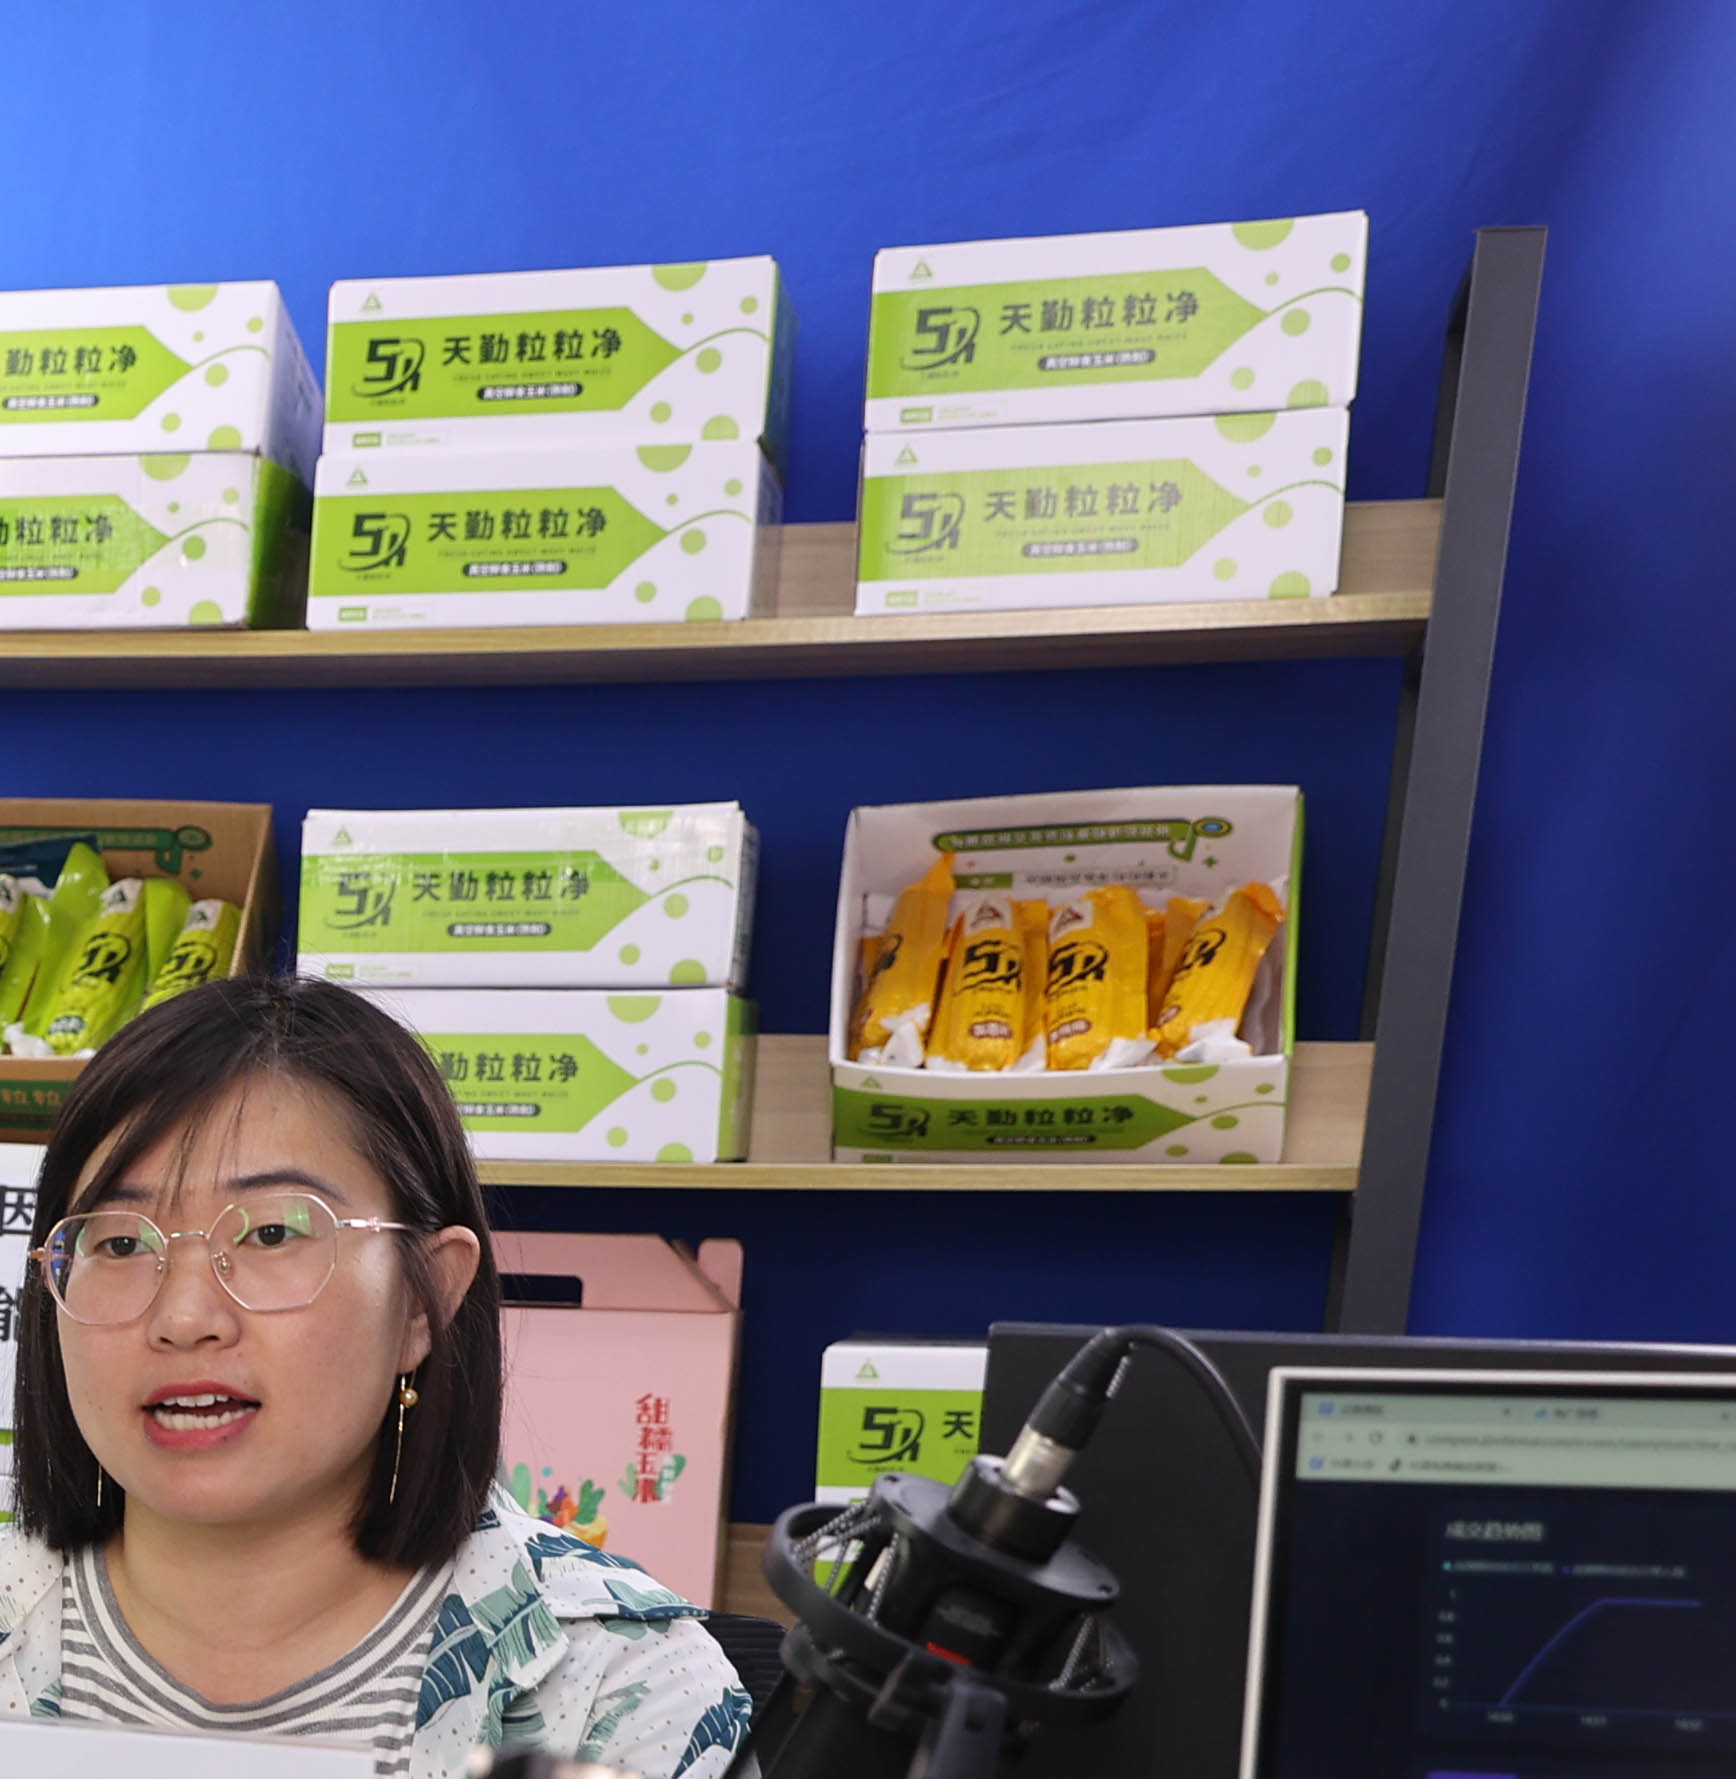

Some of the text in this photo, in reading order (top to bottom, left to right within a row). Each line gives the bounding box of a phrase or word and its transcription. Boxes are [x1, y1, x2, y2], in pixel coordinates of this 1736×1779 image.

[999, 290, 1199, 335] 天勤粒粒净
[442, 328, 622, 366] 天勤粒粒净
[984, 480, 1183, 521] 天勤粒粒净
[427, 507, 607, 541] 天勤粒粒净
[412, 869, 590, 901] 天勤粒粒净
[948, 1105, 1134, 1126] 天勤粒粒净
[943, 1410, 974, 1439] 天
